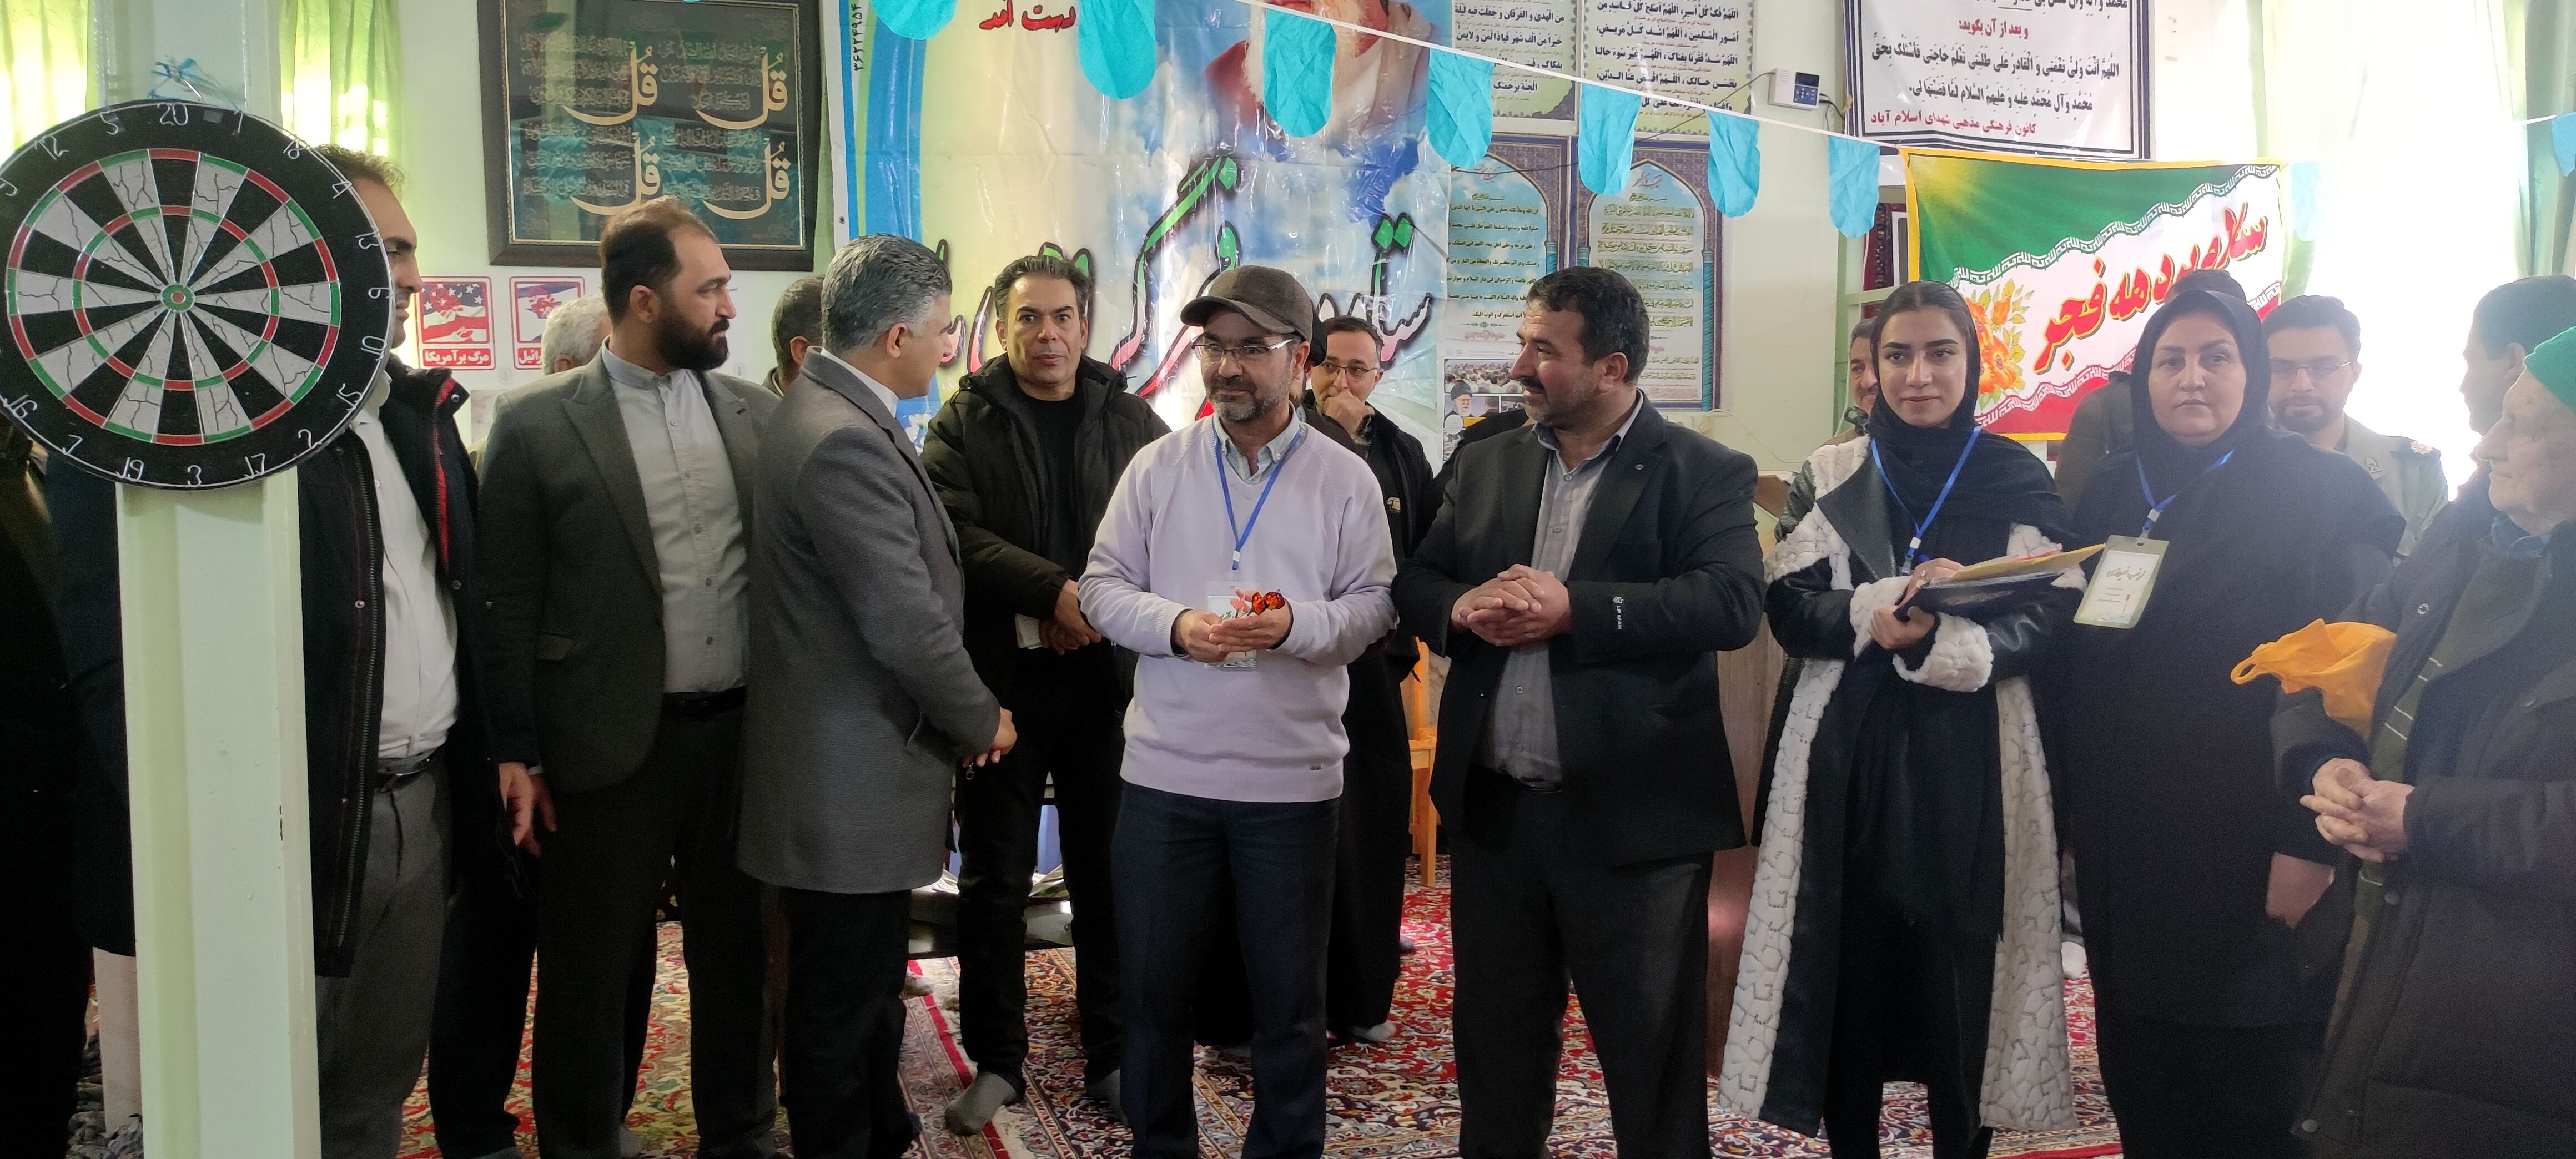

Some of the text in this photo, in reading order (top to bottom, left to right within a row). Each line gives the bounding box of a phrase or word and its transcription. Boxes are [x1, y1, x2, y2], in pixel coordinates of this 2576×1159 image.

[1985, 18, 1996, 36] آن
[1999, 21, 2006, 38] از
[2009, 24, 2021, 38] بعد
[2024, 28, 2029, 39] و
[1871, 110, 1891, 126] آباد
[1895, 110, 1921, 126] اسلام
[2015, 123, 2036, 137] کانون
[2034, 256, 2107, 376] فجر
[425, 350, 489, 365] مرگ بر آمریکا
[187, 465, 203, 487] 3
